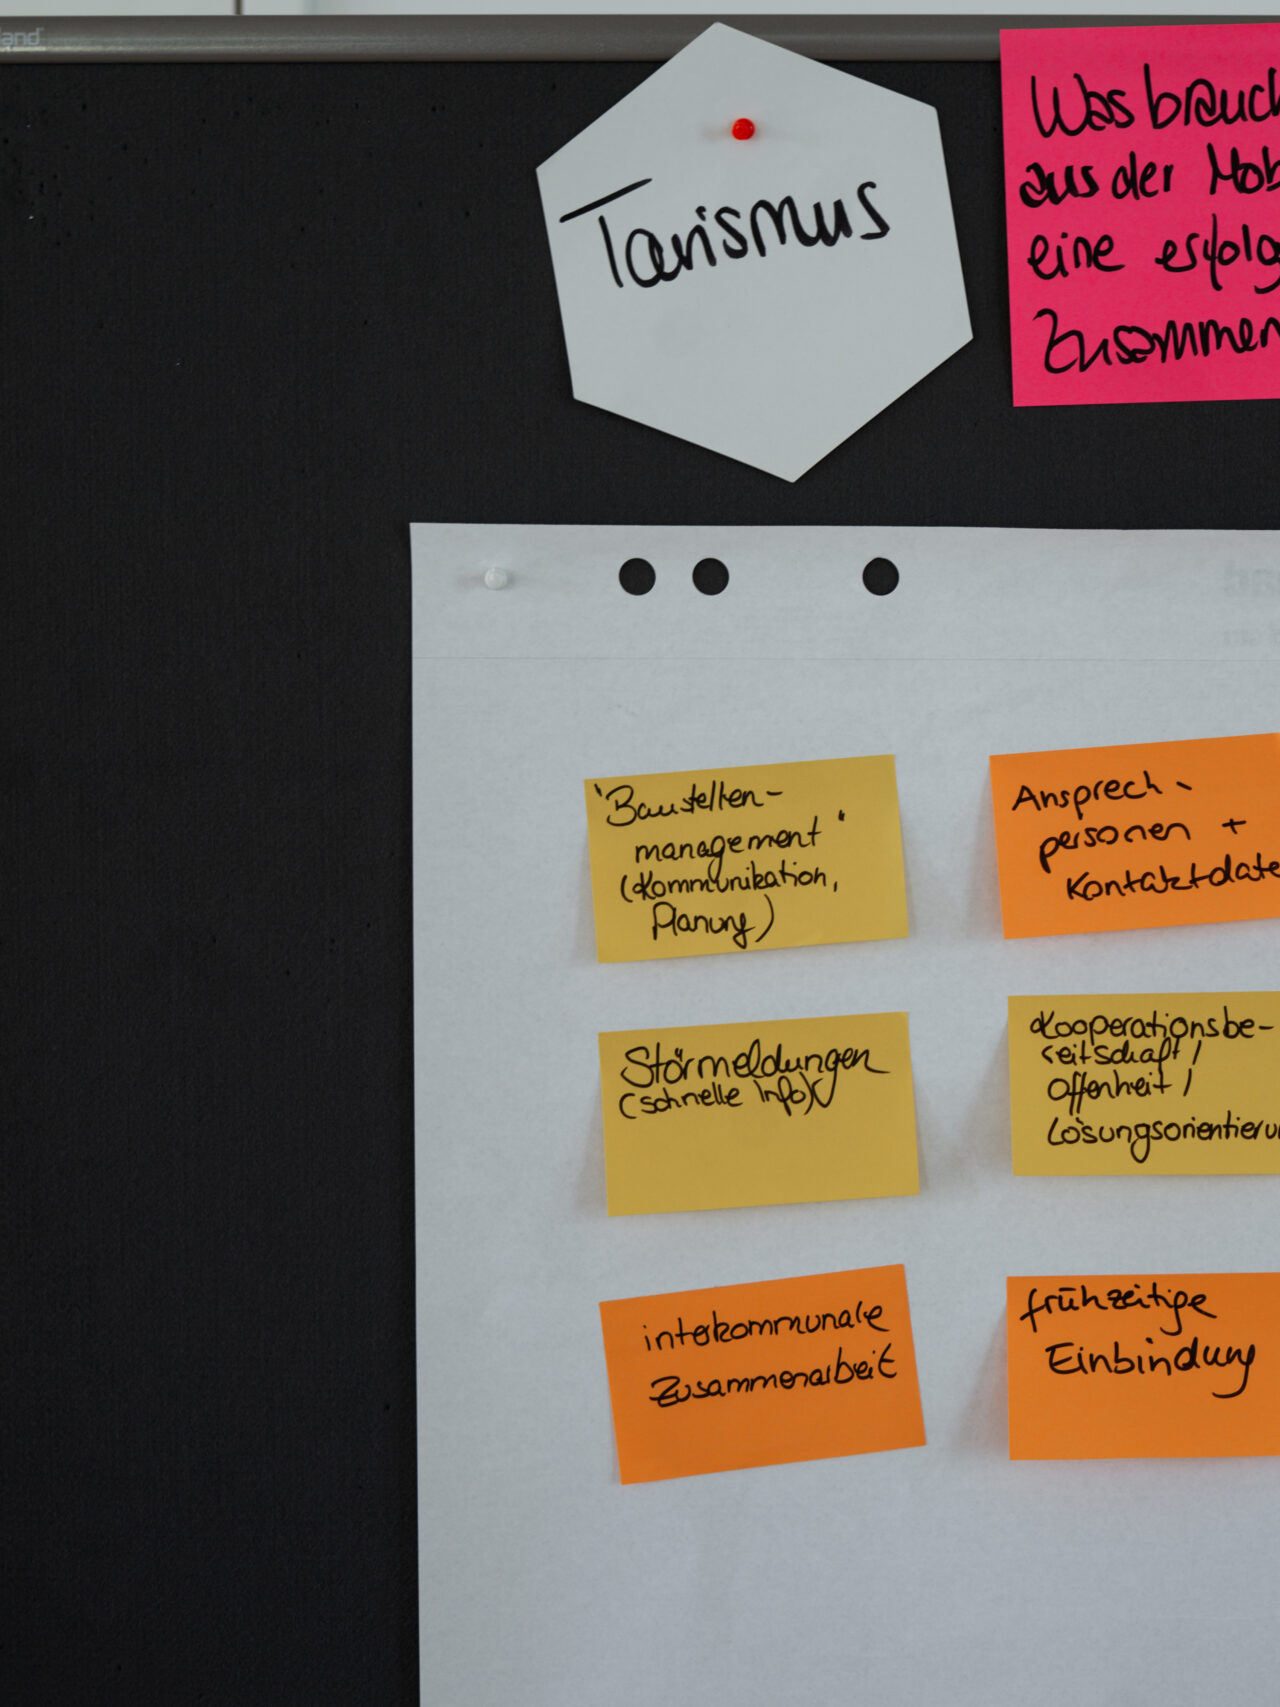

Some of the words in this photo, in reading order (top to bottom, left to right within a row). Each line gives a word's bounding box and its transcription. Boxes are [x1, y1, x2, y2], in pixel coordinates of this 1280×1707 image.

[0, 27, 41, 47] and
[1030, 73, 1136, 139] Was
[1018, 160, 1100, 209] aus
[1111, 150, 1175, 201] der
[1027, 232, 1126, 281] eine
[1038, 822, 1192, 874] personen
[1030, 1005, 1275, 1046] Kooperationsbe-
[620, 1038, 892, 1109] Störmeldungen
[618, 1082, 744, 1120] (schnelle
[642, 1300, 891, 1352] interkommunale
[1019, 1281, 1218, 1336] frühzeitige
[649, 1342, 898, 1408] Zusammenarbeit
[1045, 1336, 1256, 1399] Einbindung
